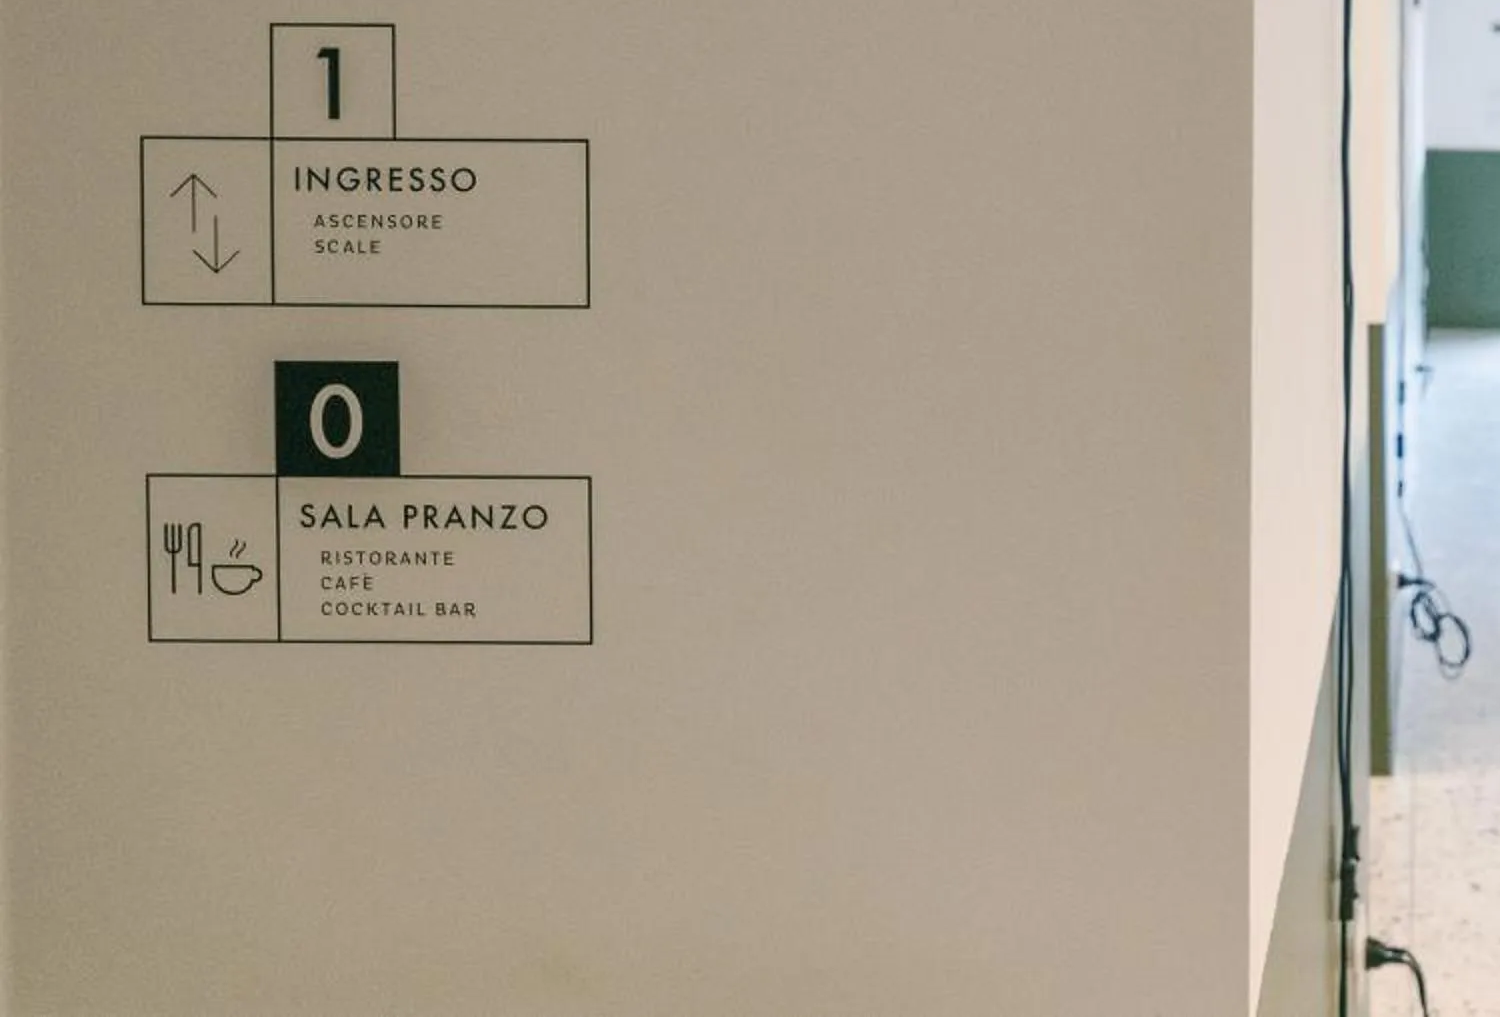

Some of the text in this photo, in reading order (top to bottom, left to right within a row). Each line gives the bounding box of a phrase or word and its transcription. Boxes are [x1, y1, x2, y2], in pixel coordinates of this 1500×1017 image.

[317, 47, 340, 120] 1
[295, 167, 476, 192] INGRESSO
[314, 215, 441, 229] ASCENSORE
[315, 239, 380, 254] SCALE
[310, 384, 362, 459] 0
[300, 503, 548, 529] SALA PRANZO
[321, 551, 455, 566] RISTORANTE
[321, 601, 476, 617] COCKTAIL BAR
